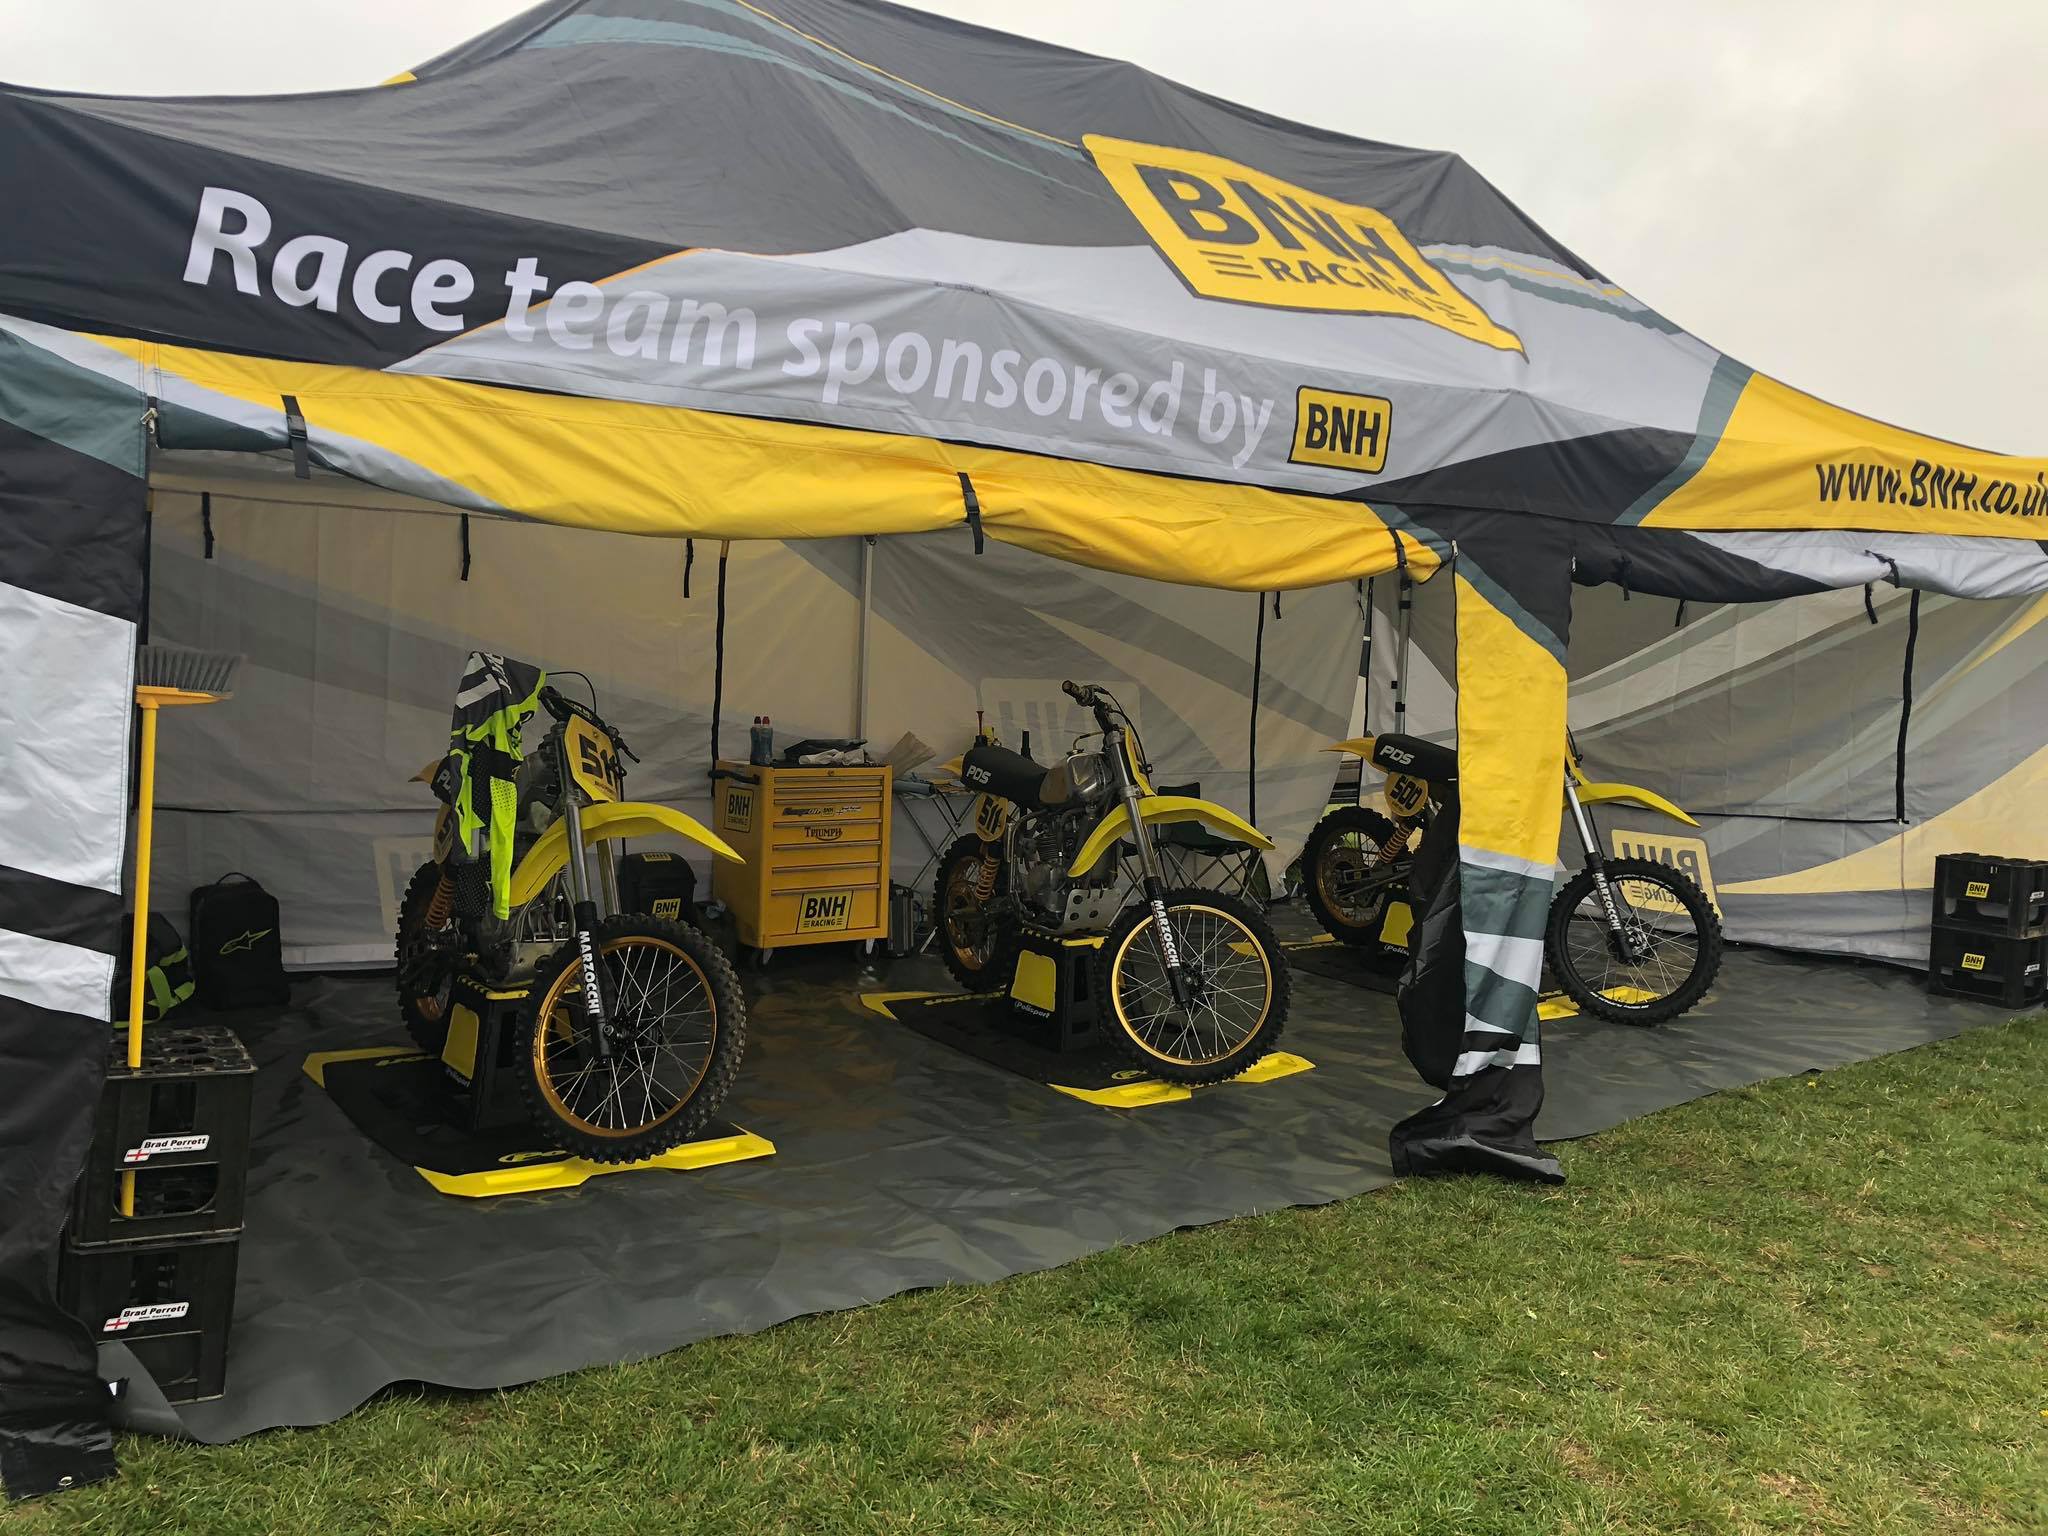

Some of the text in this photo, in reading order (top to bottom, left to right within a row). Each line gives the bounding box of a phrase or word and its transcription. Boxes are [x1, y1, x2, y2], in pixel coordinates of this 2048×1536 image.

[1135, 164, 1439, 296] BNH
[183, 187, 1274, 469] Race team sponsored by
[1305, 403, 1381, 457] BNH
[1379, 745, 1415, 765] PDS
[966, 765, 991, 784] PDS
[1390, 775, 1422, 810] 500
[728, 794, 750, 816] BNH
[1969, 883, 1987, 893] BNH
[655, 902, 677, 913] BNH
[805, 896, 847, 918] BNH
[1593, 872, 1621, 930] MARZOCCHI
[810, 919, 835, 927] RACING
[1154, 900, 1180, 967] MARZOCCHI
[1965, 955, 1983, 965] BNH
[579, 930, 600, 1014] MARZOCCHI
[144, 1140, 168, 1149] Brad
[123, 1308, 147, 1318] Brad
